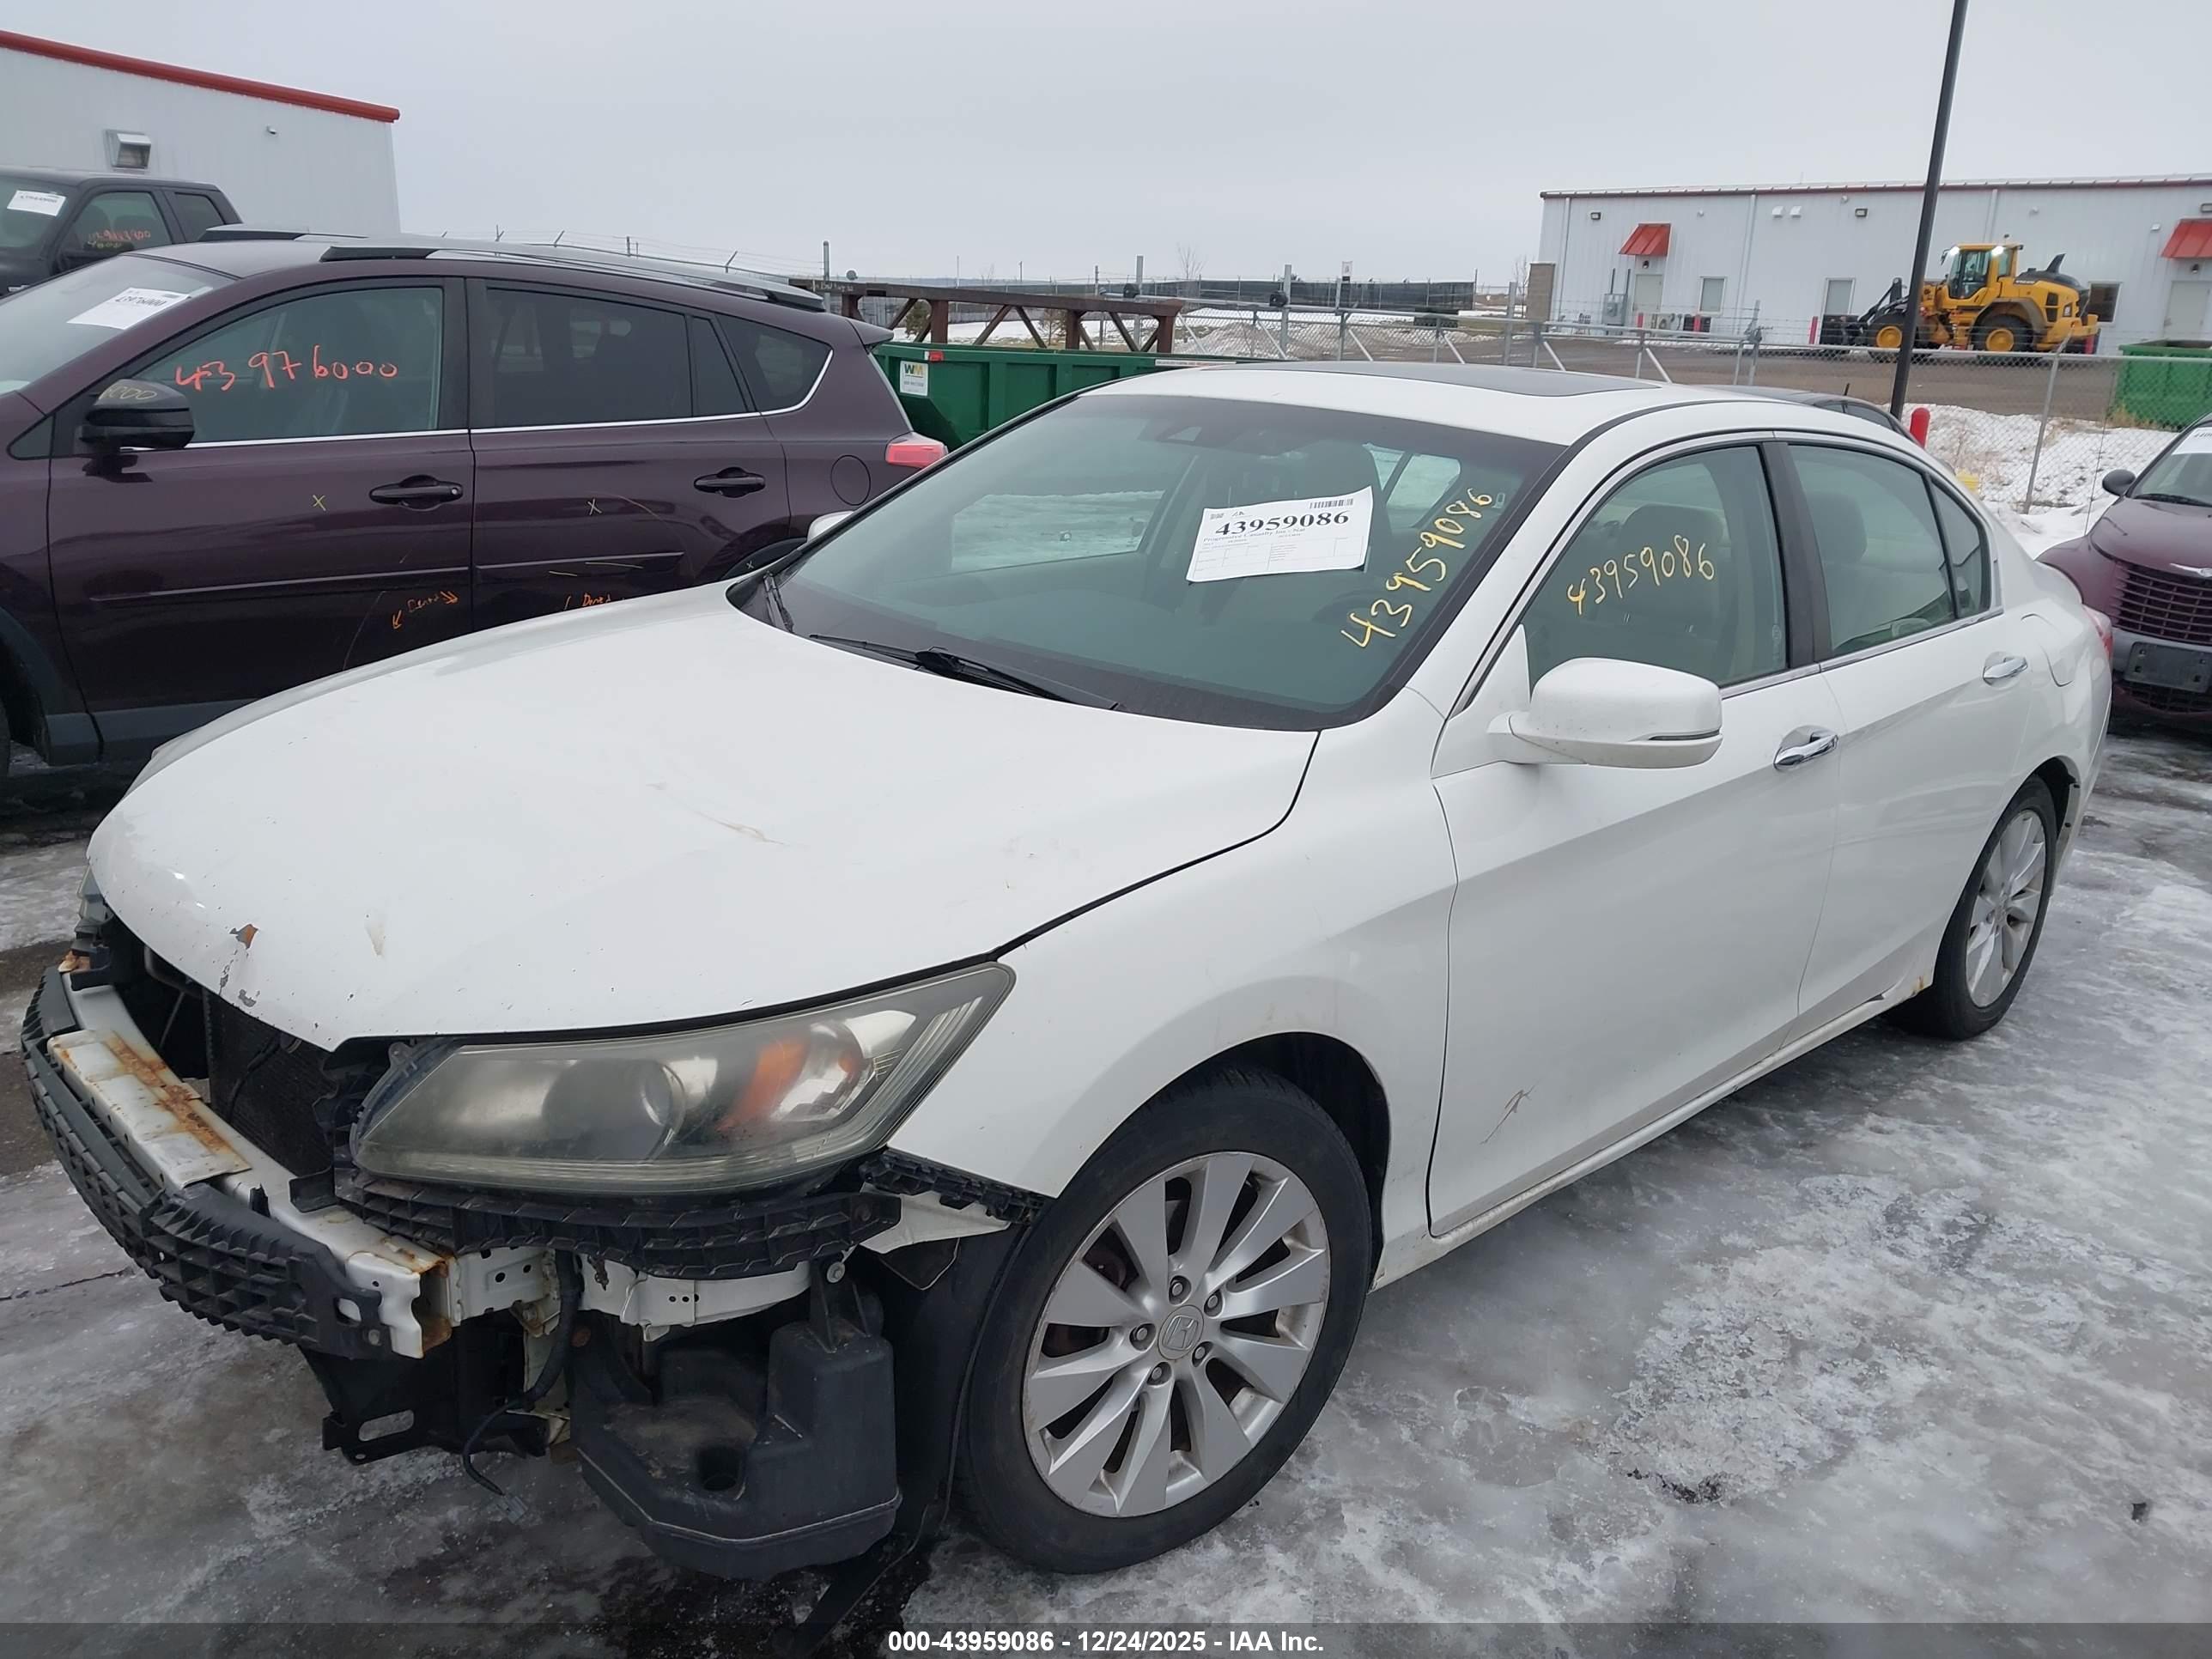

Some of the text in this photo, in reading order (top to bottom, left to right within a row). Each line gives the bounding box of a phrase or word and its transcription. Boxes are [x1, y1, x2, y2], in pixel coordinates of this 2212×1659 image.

[1215, 509, 1350, 536] 43959086
[1340, 487, 1493, 648] 43959086
[1567, 534, 1715, 616] 43959086
